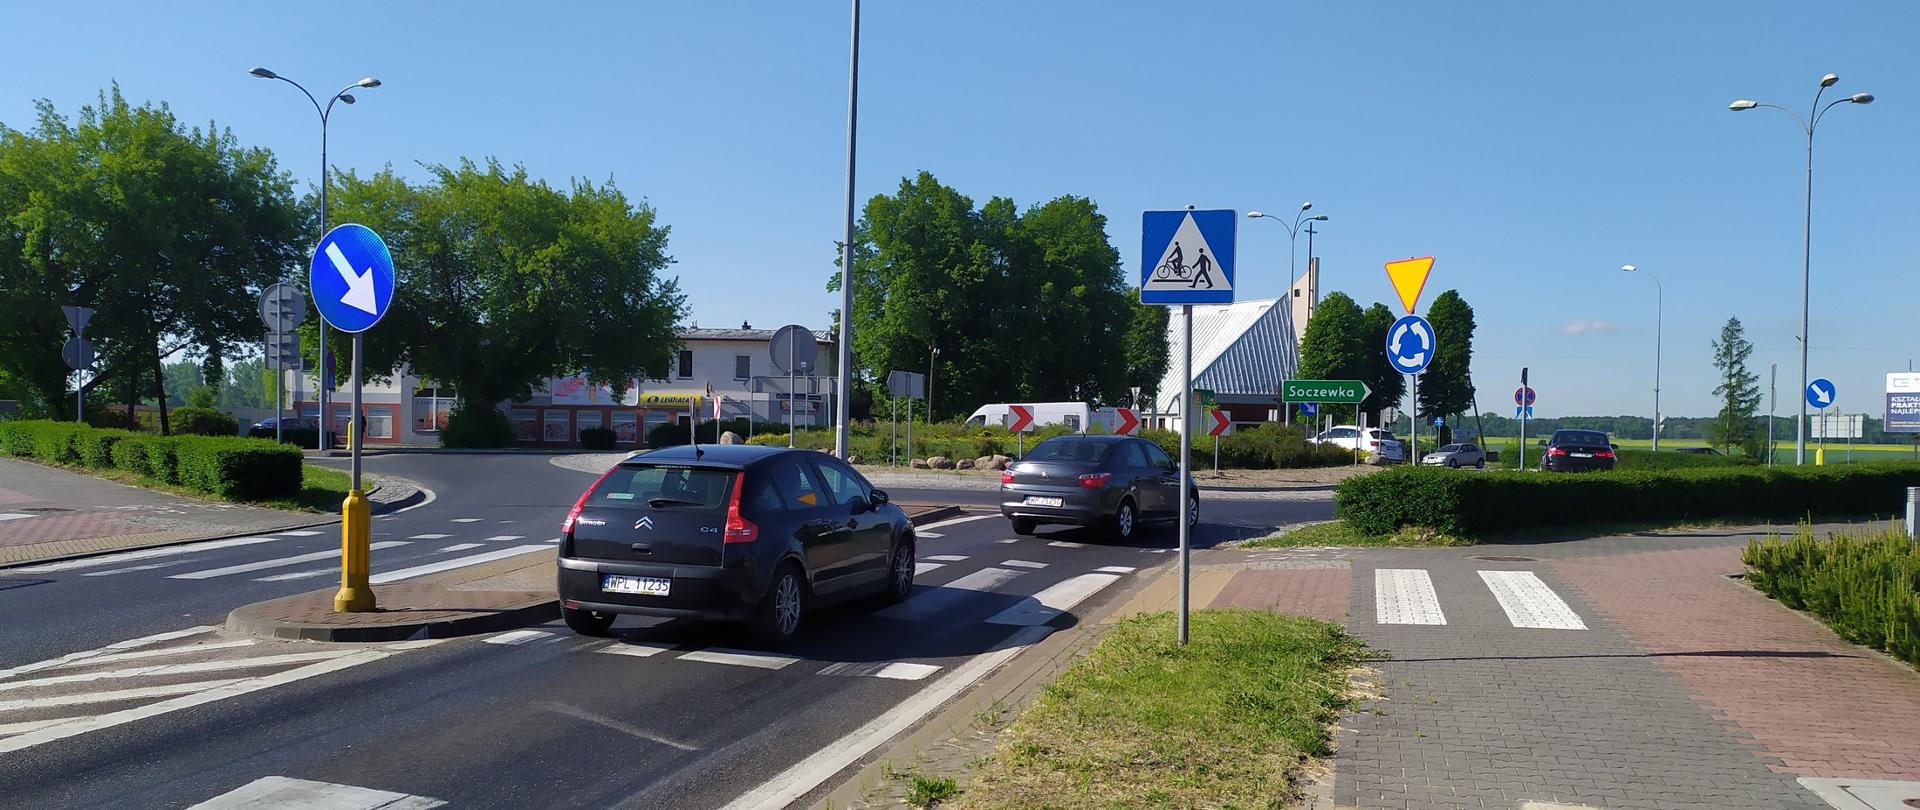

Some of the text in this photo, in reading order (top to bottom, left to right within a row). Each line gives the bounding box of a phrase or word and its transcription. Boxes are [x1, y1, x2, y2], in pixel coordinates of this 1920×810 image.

[1289, 386, 1354, 397] Soczewka
[700, 526, 718, 534] C4
[610, 576, 668, 592] WPL 11235
